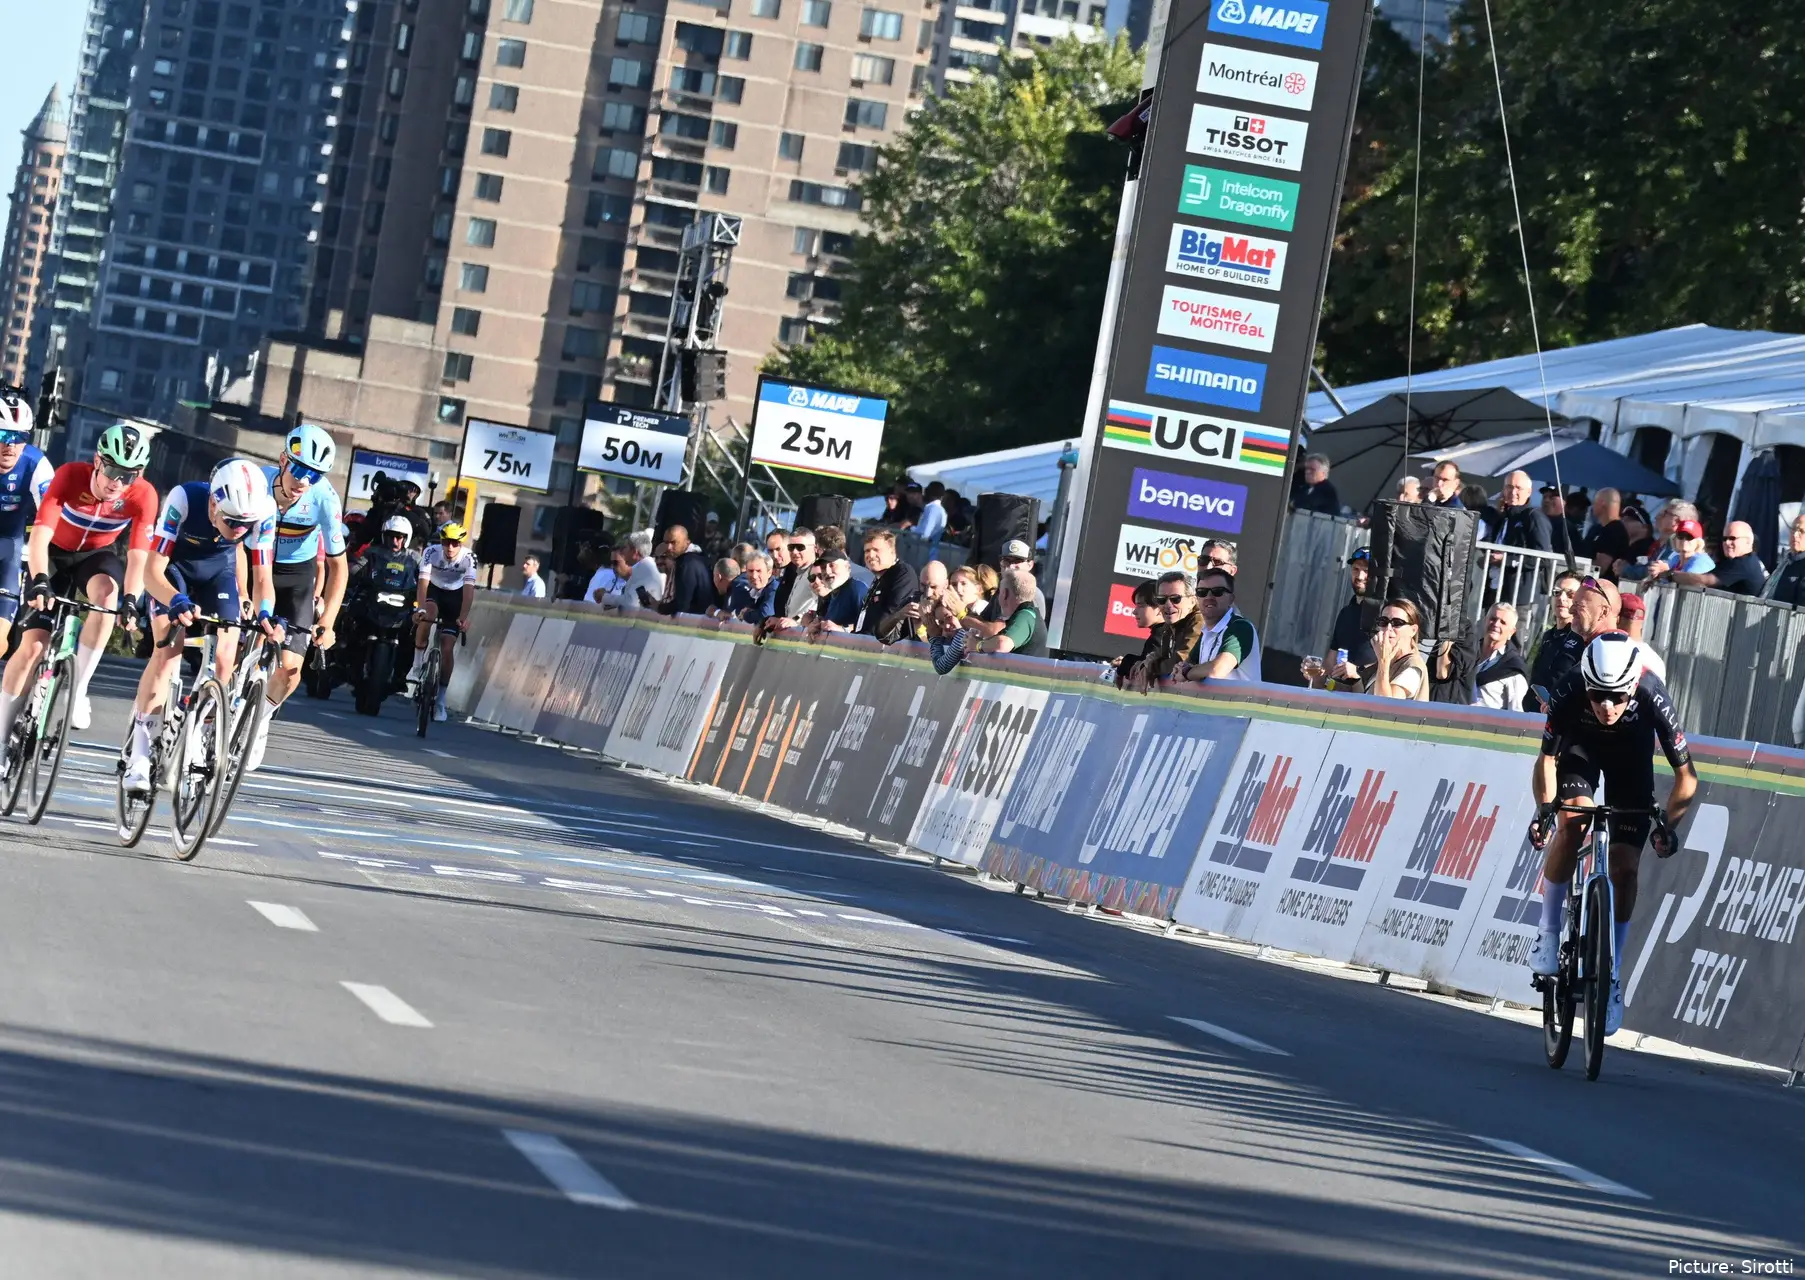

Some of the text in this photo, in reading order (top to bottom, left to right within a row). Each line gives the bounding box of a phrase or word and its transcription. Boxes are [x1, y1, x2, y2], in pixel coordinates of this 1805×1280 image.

[1249, 5, 1320, 34] MAPEI
[1209, 62, 1283, 88] Montréal
[1206, 128, 1288, 155] TISSOT
[1222, 179, 1283, 202] Intelcom
[1219, 196, 1290, 223] Dragonfly
[1179, 229, 1276, 268] BigMat
[1176, 262, 1269, 285] HOME OF BUILDERS
[1155, 363, 1257, 395] SHIMANO
[810, 392, 861, 414] MAPEI
[632, 421, 649, 429] TECH
[633, 415, 660, 425] PREMIER
[781, 422, 852, 460] 25M
[1155, 415, 1237, 460] UCI
[375, 457, 409, 470] beneva
[483, 449, 532, 478] 75M
[601, 437, 663, 470] 50M
[1139, 478, 1235, 517] beneva
[1125, 566, 1154, 576] VIRTUAL
[1104, 734, 1217, 858] MAPEI
[1220, 751, 1302, 865] BigMat
[1301, 764, 1398, 883] BigMat
[1405, 778, 1500, 901] BigMat
[1195, 871, 1221, 898] HOME
[1215, 875, 1232, 901] OF
[1276, 888, 1353, 926] HOME OF BUILDERS
[1379, 908, 1453, 947] HOME OF BUILDERS
[1477, 929, 1506, 960] HOME
[1672, 948, 1747, 1029] TECH
